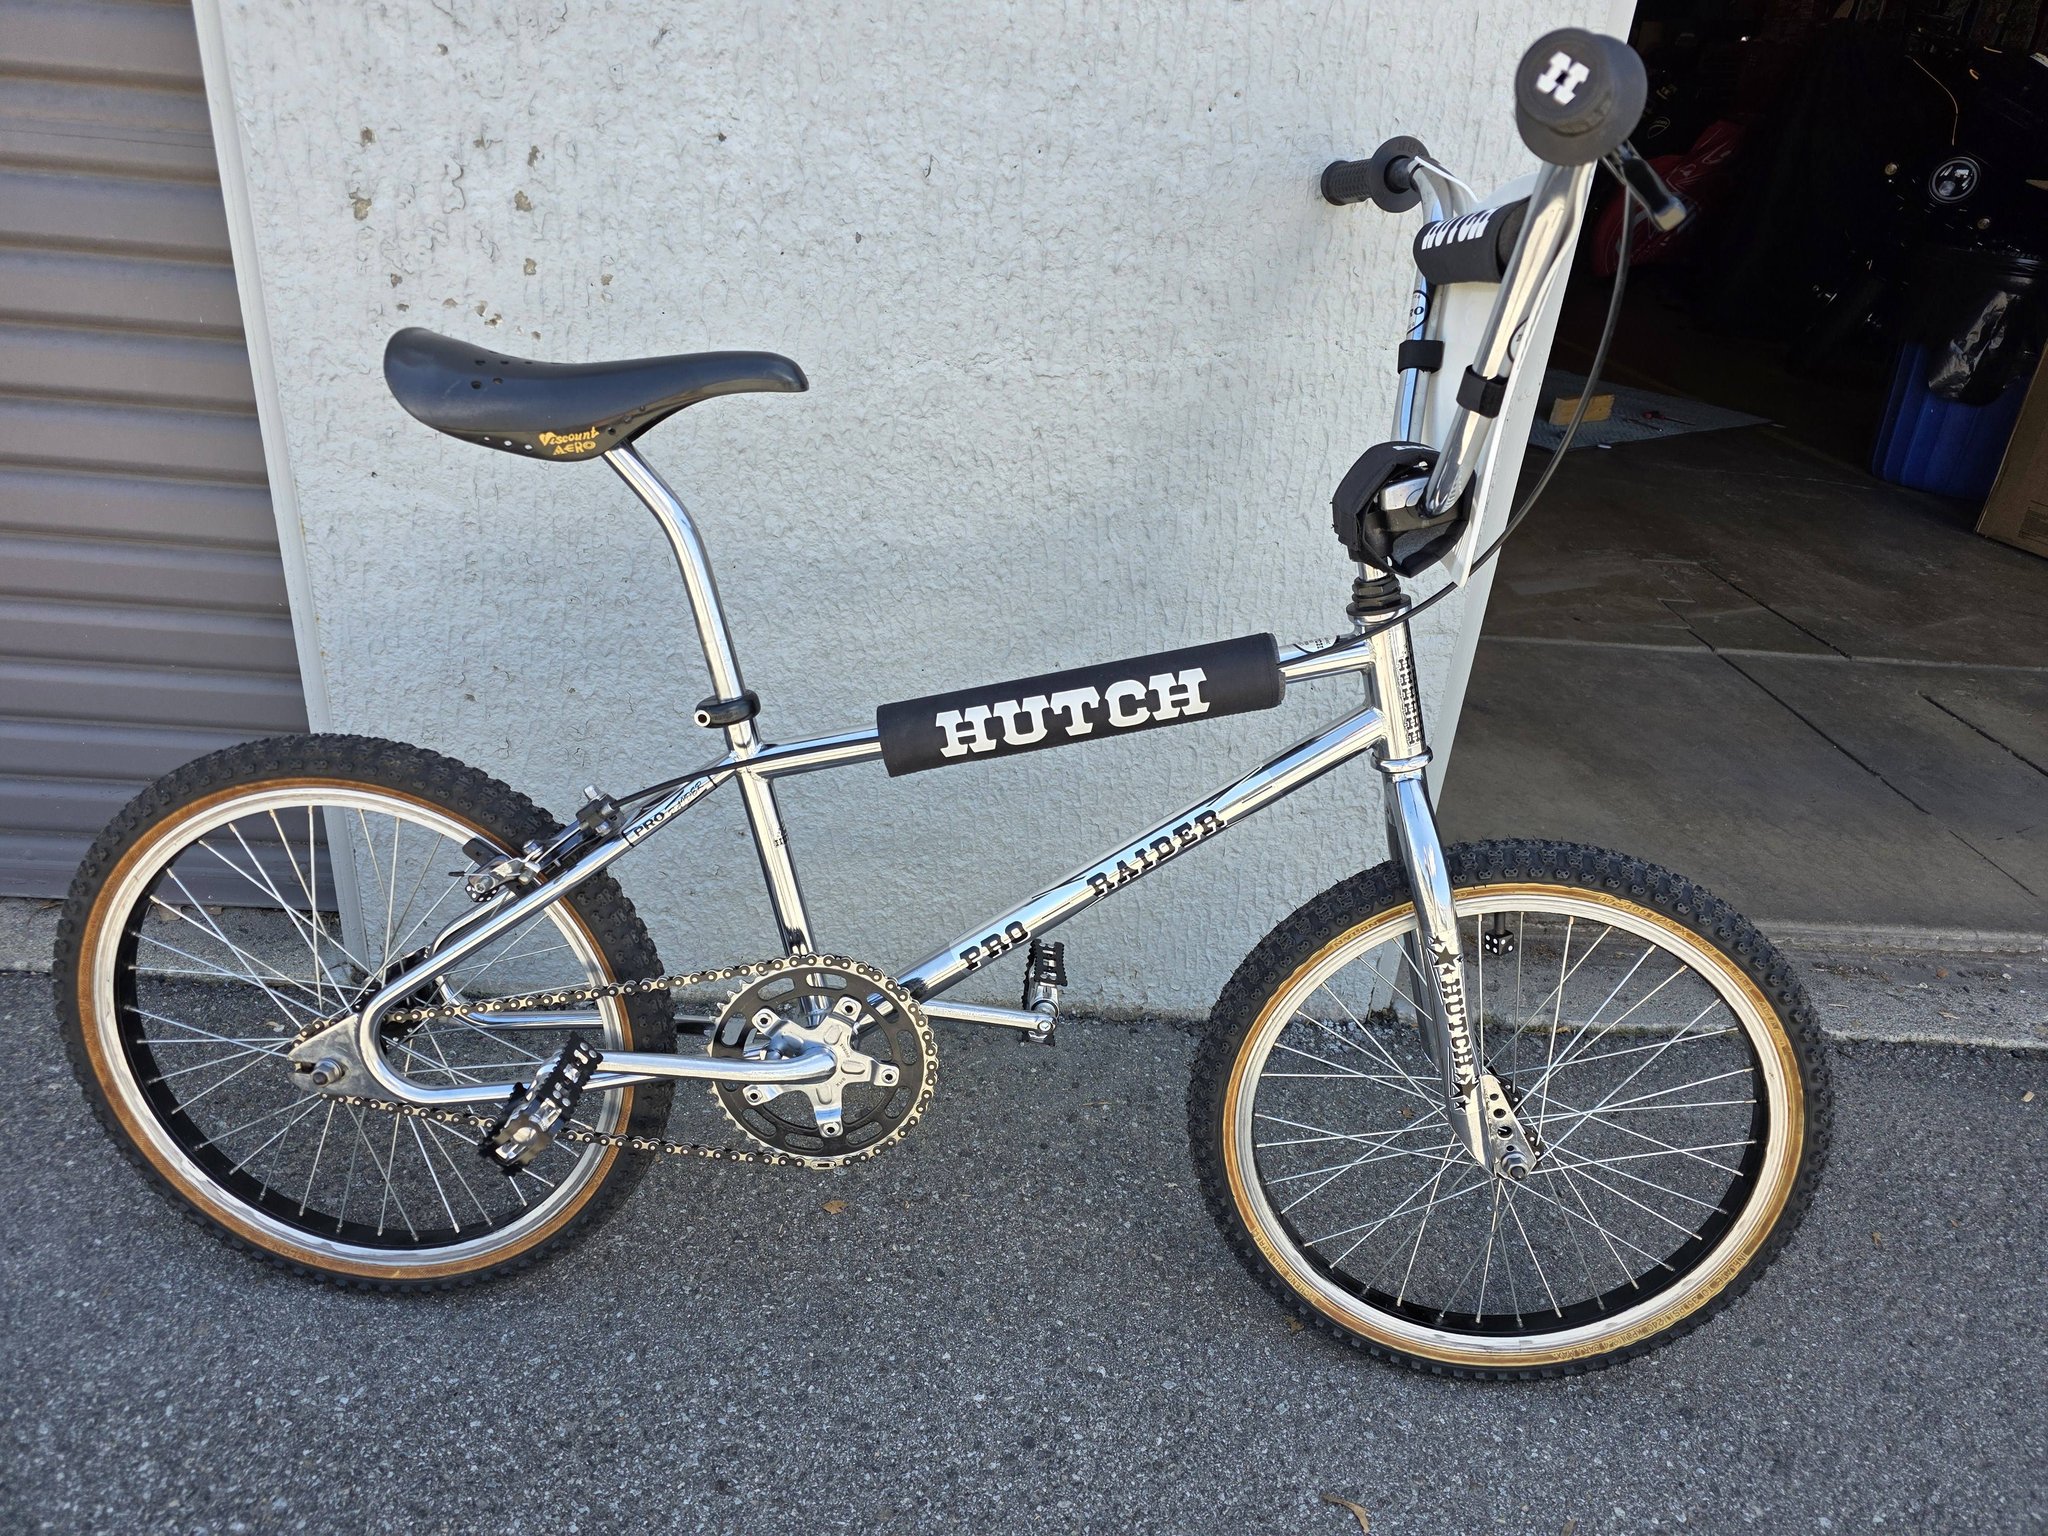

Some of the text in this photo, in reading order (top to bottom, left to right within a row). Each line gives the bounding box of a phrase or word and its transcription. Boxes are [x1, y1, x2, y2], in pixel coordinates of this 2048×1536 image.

[1535, 51, 1590, 105] H
[553, 441, 596, 455] AERO
[935, 668, 1211, 758] HUTCH
[634, 812, 665, 838] PRO
[959, 809, 1228, 970] PRO RAIDER
[1441, 978, 1474, 1076] HUTCH
